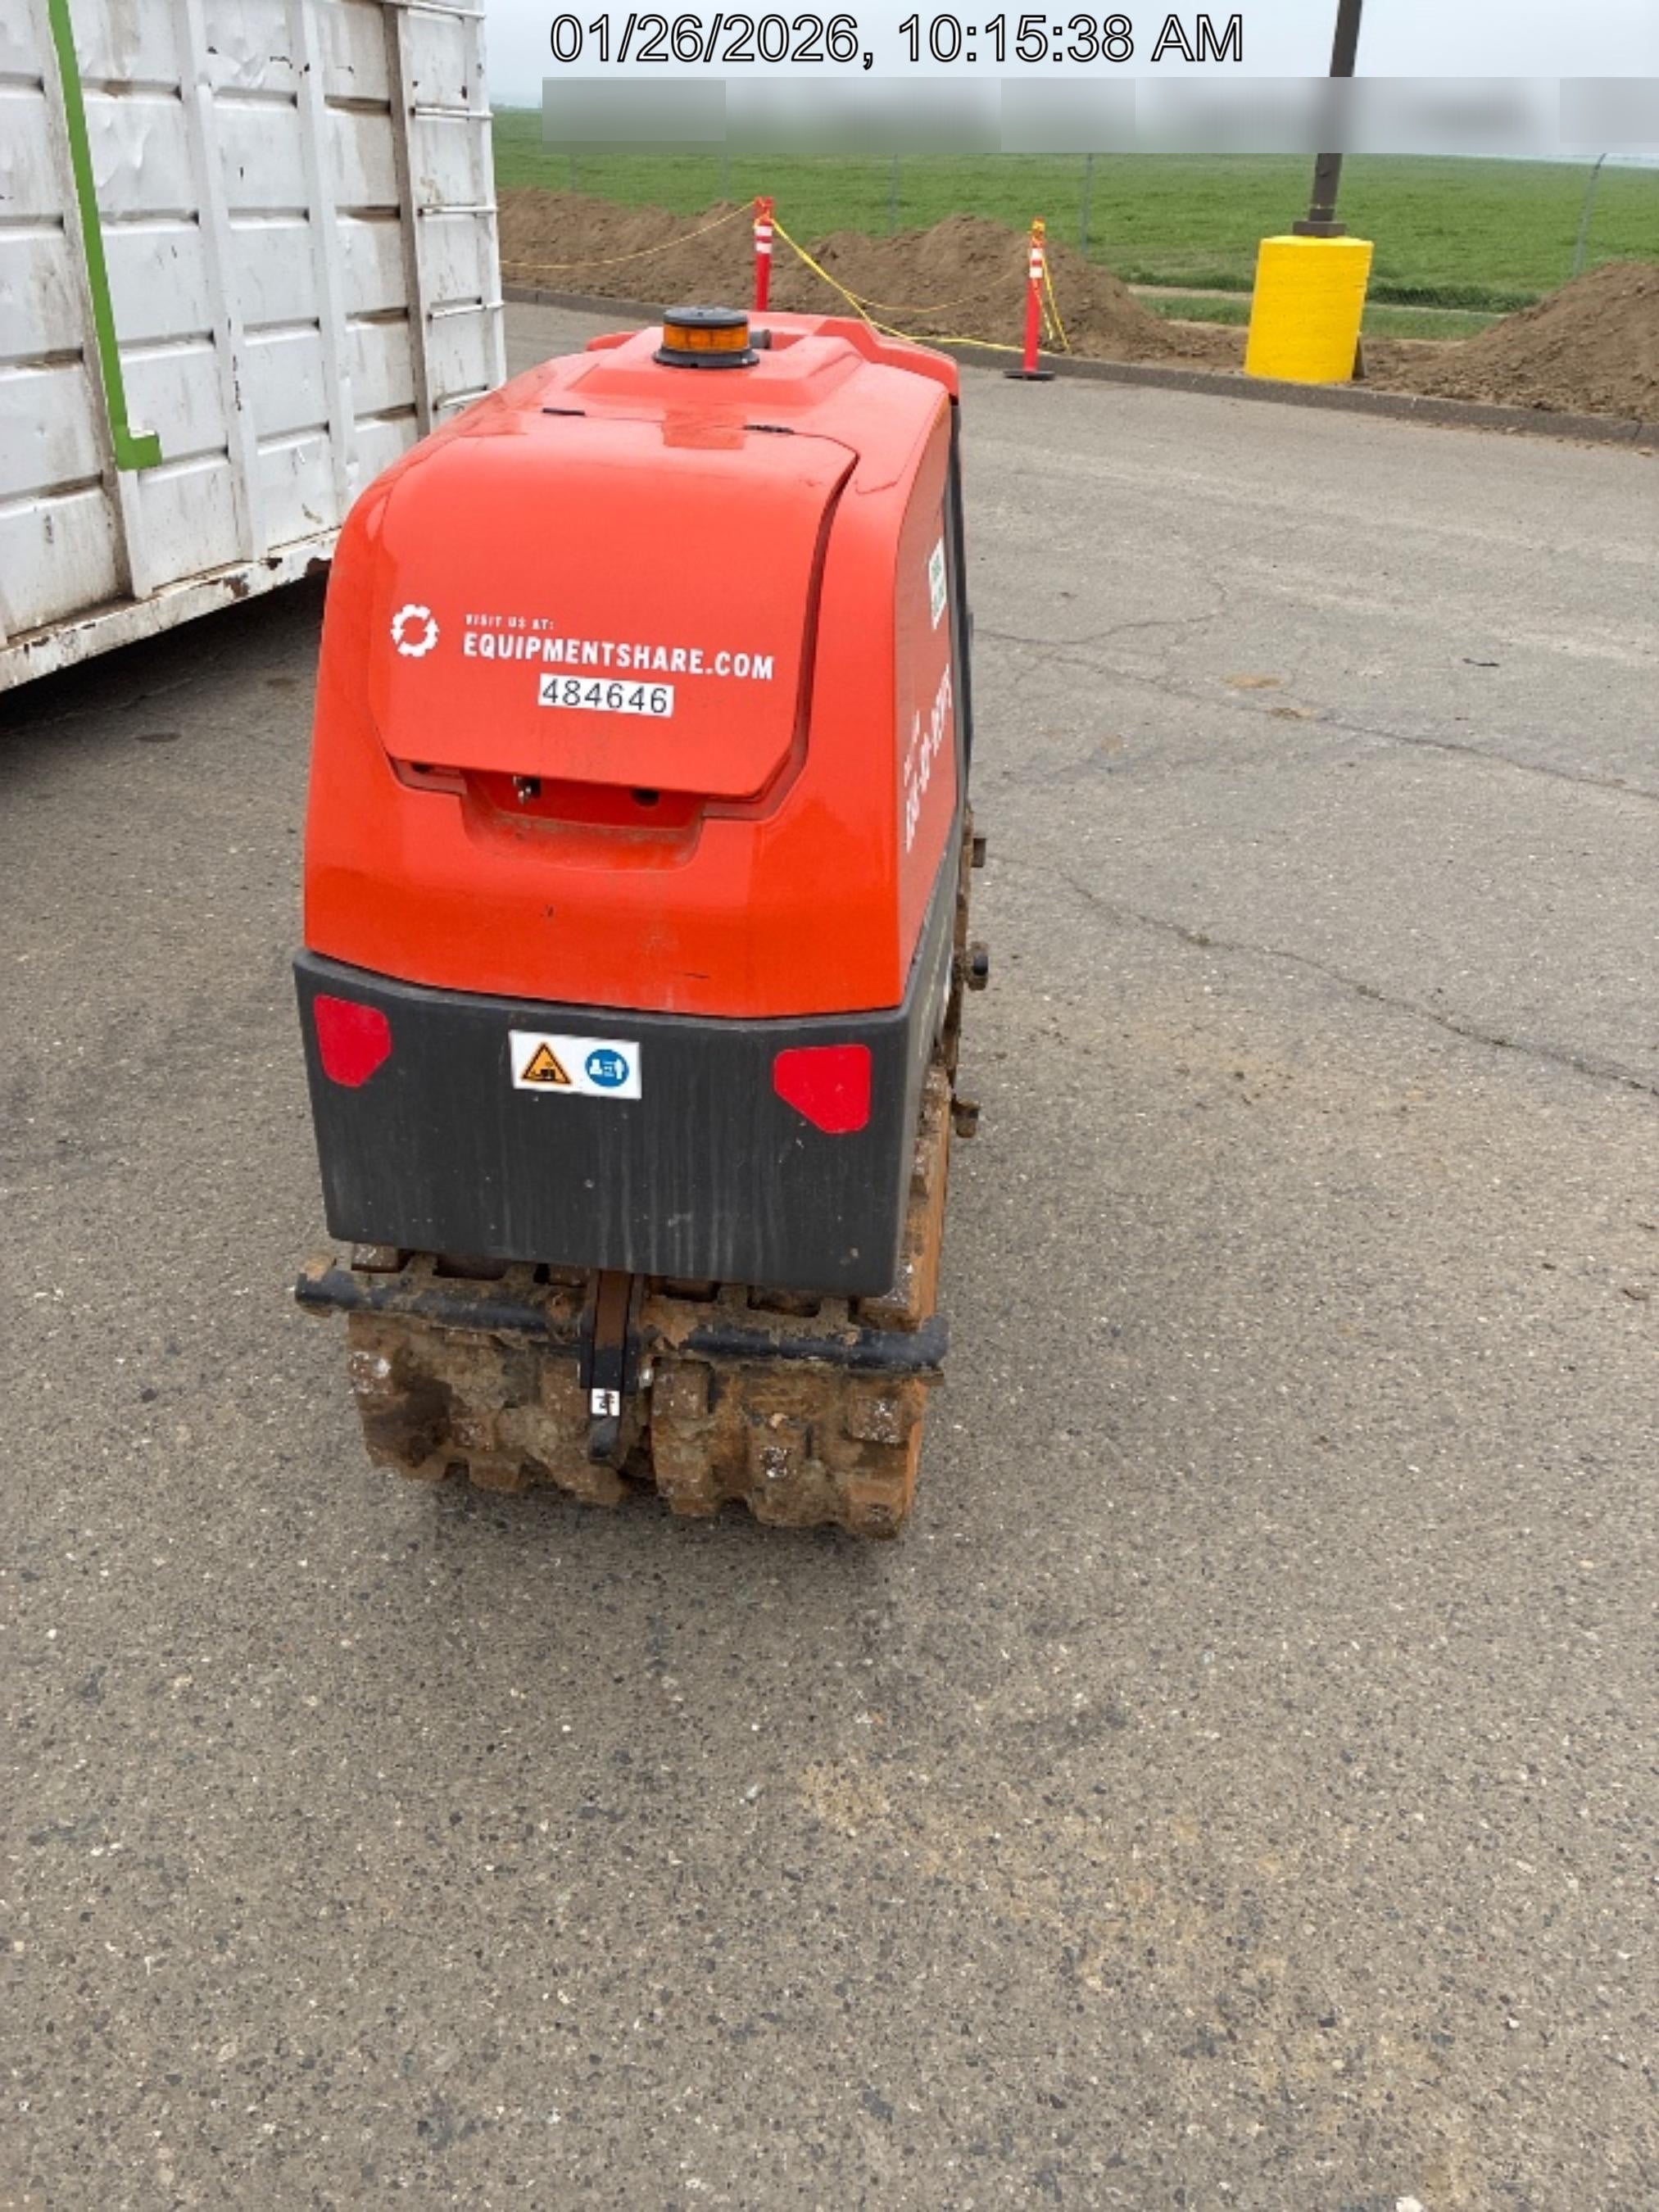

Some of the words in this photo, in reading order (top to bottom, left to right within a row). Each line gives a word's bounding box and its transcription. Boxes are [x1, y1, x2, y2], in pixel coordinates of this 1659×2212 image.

[465, 614, 502, 628] VISIT
[508, 616, 526, 629] US
[532, 619, 554, 630] AT:
[463, 632, 775, 680] EQUIPMENTSHARE.COM
[542, 678, 668, 714] 484646
